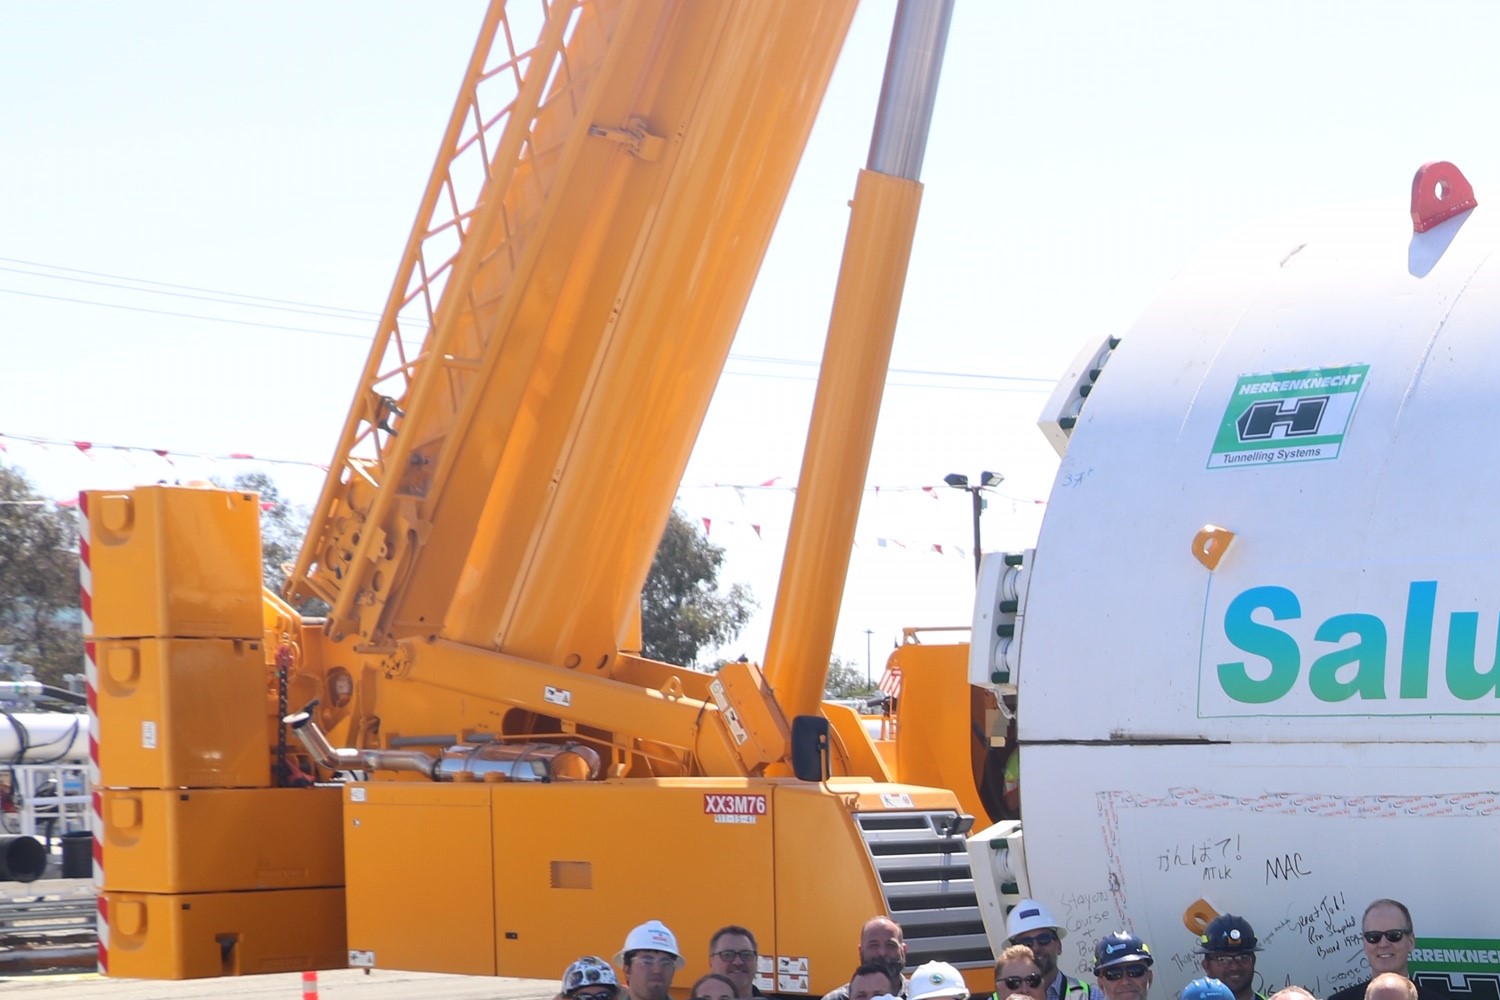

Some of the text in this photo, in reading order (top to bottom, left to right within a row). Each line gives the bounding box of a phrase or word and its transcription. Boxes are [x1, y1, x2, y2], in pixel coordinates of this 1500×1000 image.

[1239, 374, 1361, 395] HERRENKNECHT
[1223, 448, 1321, 464] Tunnelling Systems
[705, 796, 766, 814] XX3M76
[1266, 853, 1311, 885] MAC
